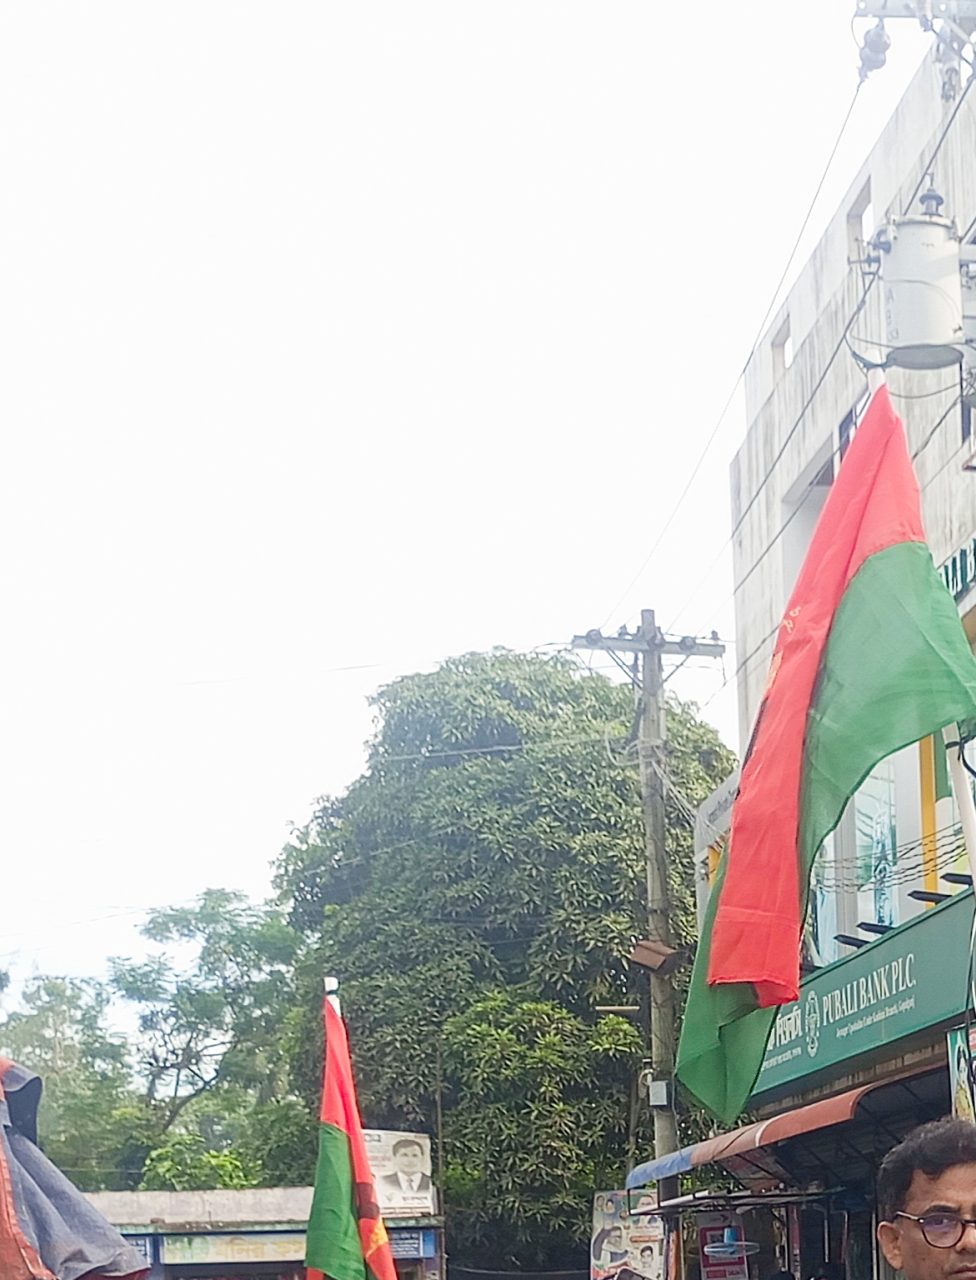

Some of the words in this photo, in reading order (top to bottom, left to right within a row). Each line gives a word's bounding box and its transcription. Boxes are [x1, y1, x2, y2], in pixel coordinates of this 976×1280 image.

[822, 980, 859, 1026] PUBALI
[859, 964, 890, 1010] BANK
[891, 953, 917, 995] PLC.
